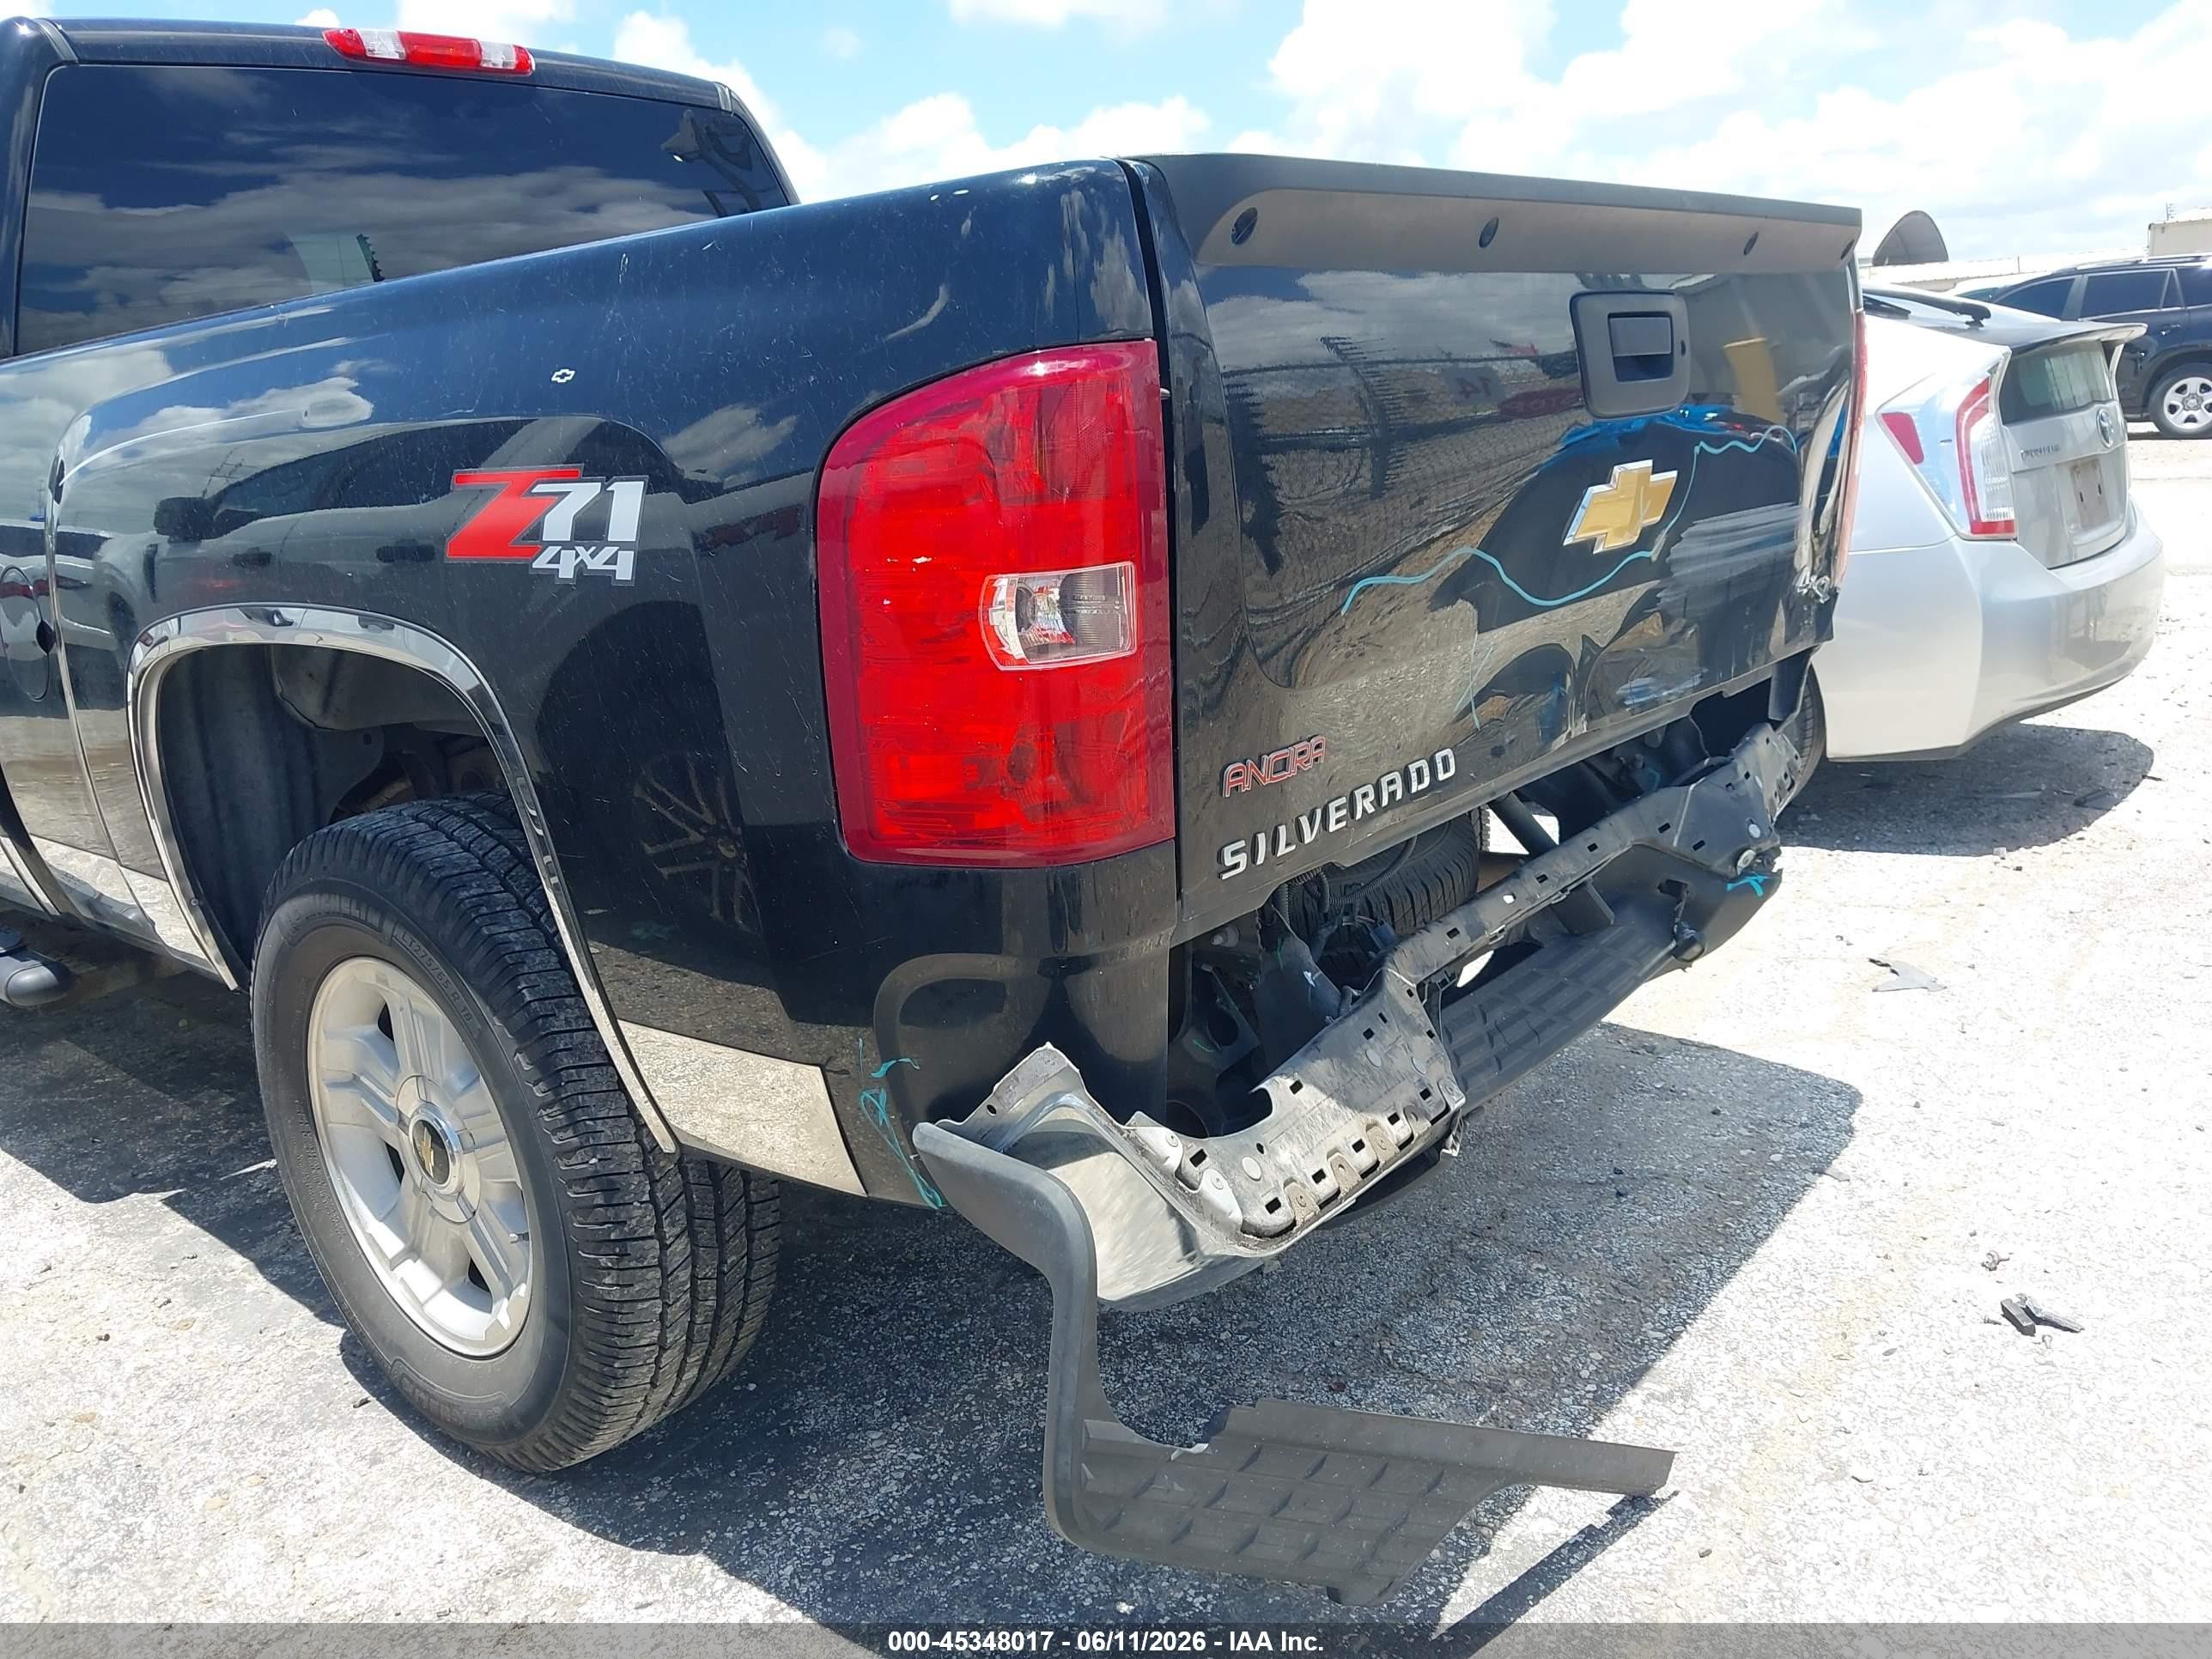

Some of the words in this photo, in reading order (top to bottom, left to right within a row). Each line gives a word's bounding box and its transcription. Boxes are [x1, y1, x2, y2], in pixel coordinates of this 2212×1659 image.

[447, 468, 645, 560] Z71
[1222, 734, 1327, 798] ANCIRA
[1219, 748, 1455, 880] SILVERADO
[451, 991, 460, 1003] R
